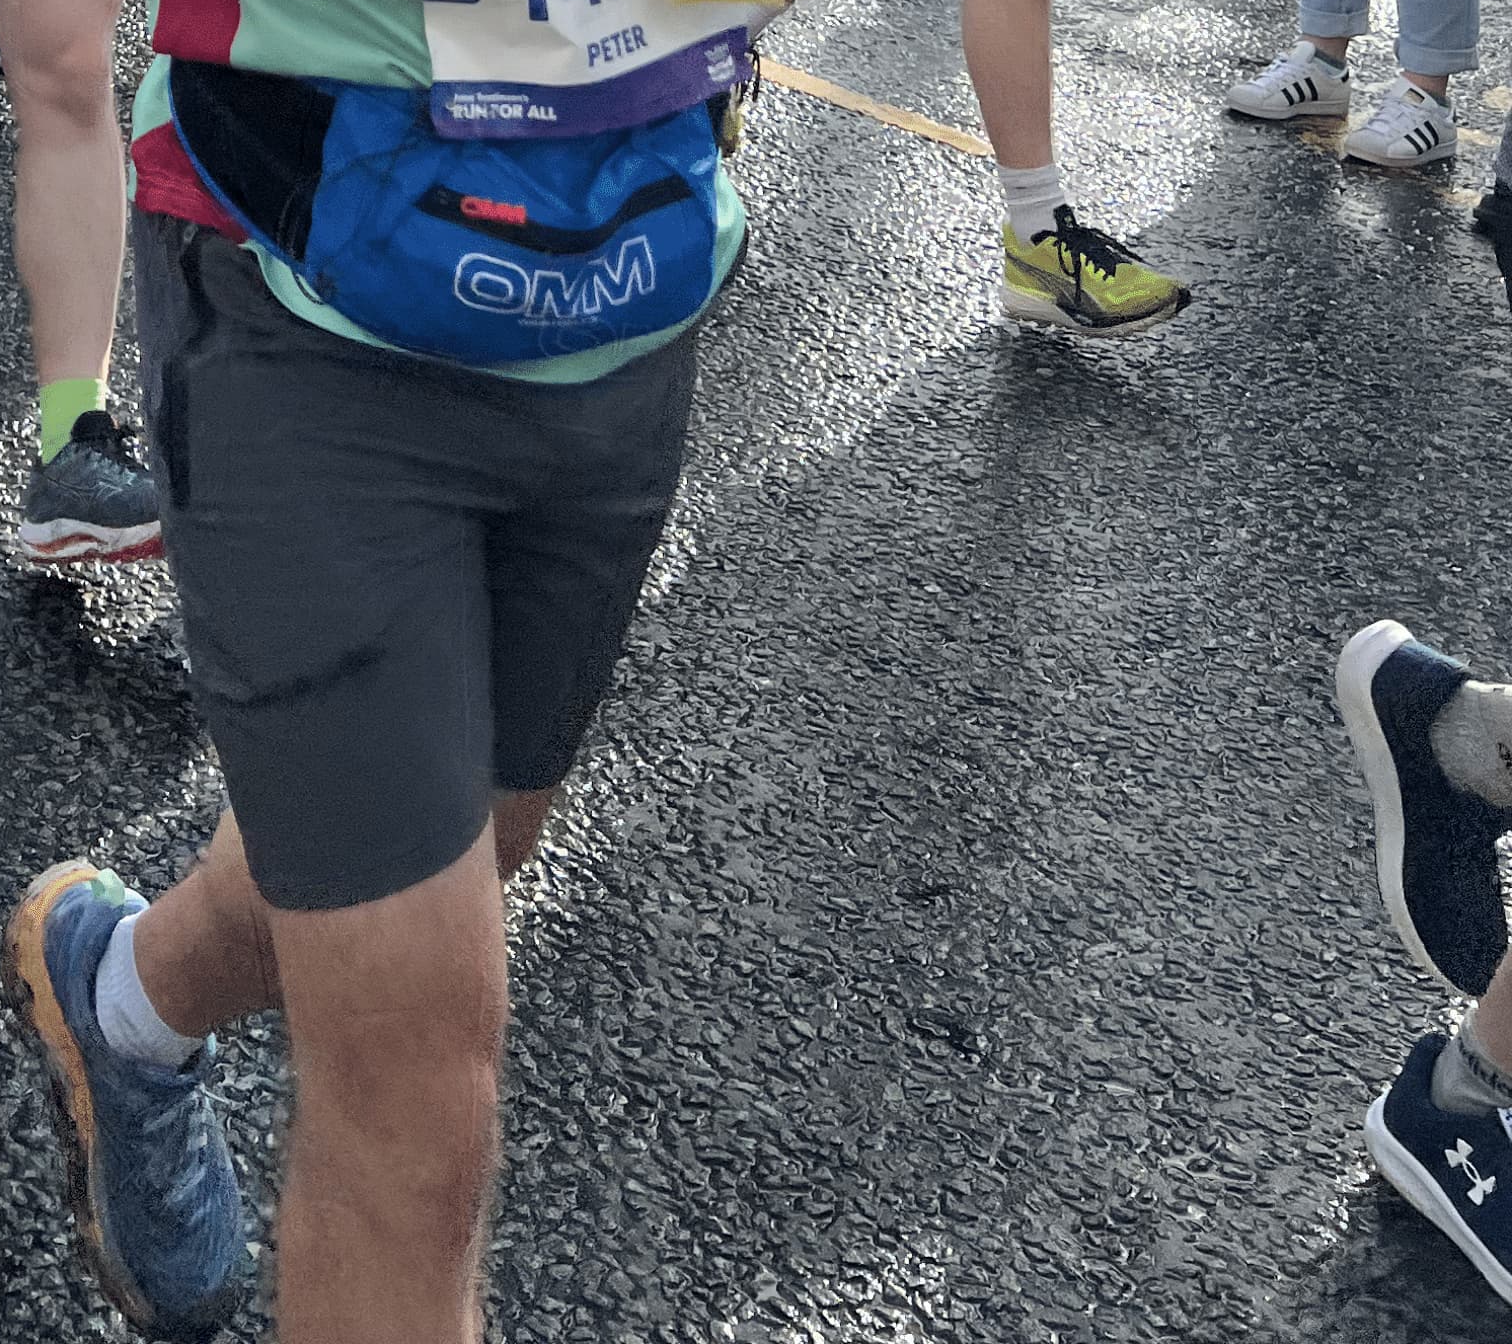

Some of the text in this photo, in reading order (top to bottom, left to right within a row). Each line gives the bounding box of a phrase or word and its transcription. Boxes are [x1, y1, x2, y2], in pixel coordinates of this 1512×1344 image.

[587, 24, 648, 67] PETER
[526, 104, 557, 121] ALL
[454, 234, 656, 319] OMM
